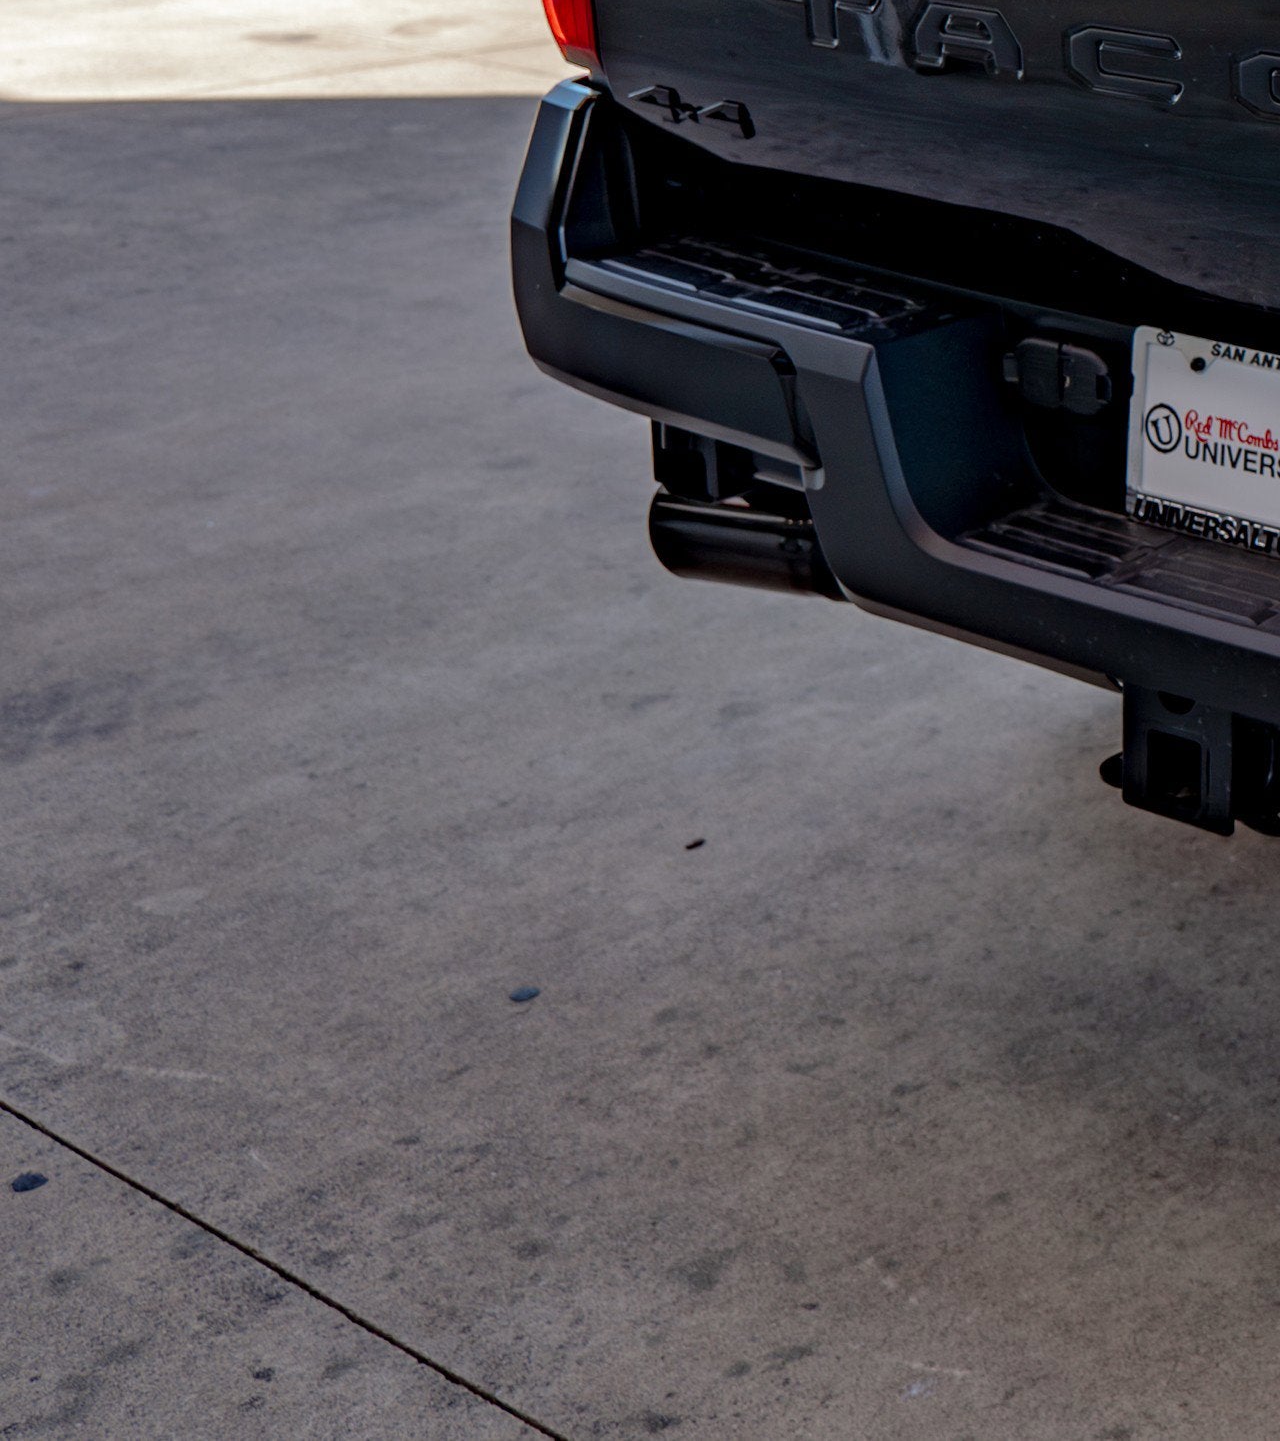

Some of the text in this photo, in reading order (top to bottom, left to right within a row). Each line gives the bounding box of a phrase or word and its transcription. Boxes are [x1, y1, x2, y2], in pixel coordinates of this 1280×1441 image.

[1210, 342, 1245, 363] SAN
[1184, 408, 1279, 452] Red McCombs
